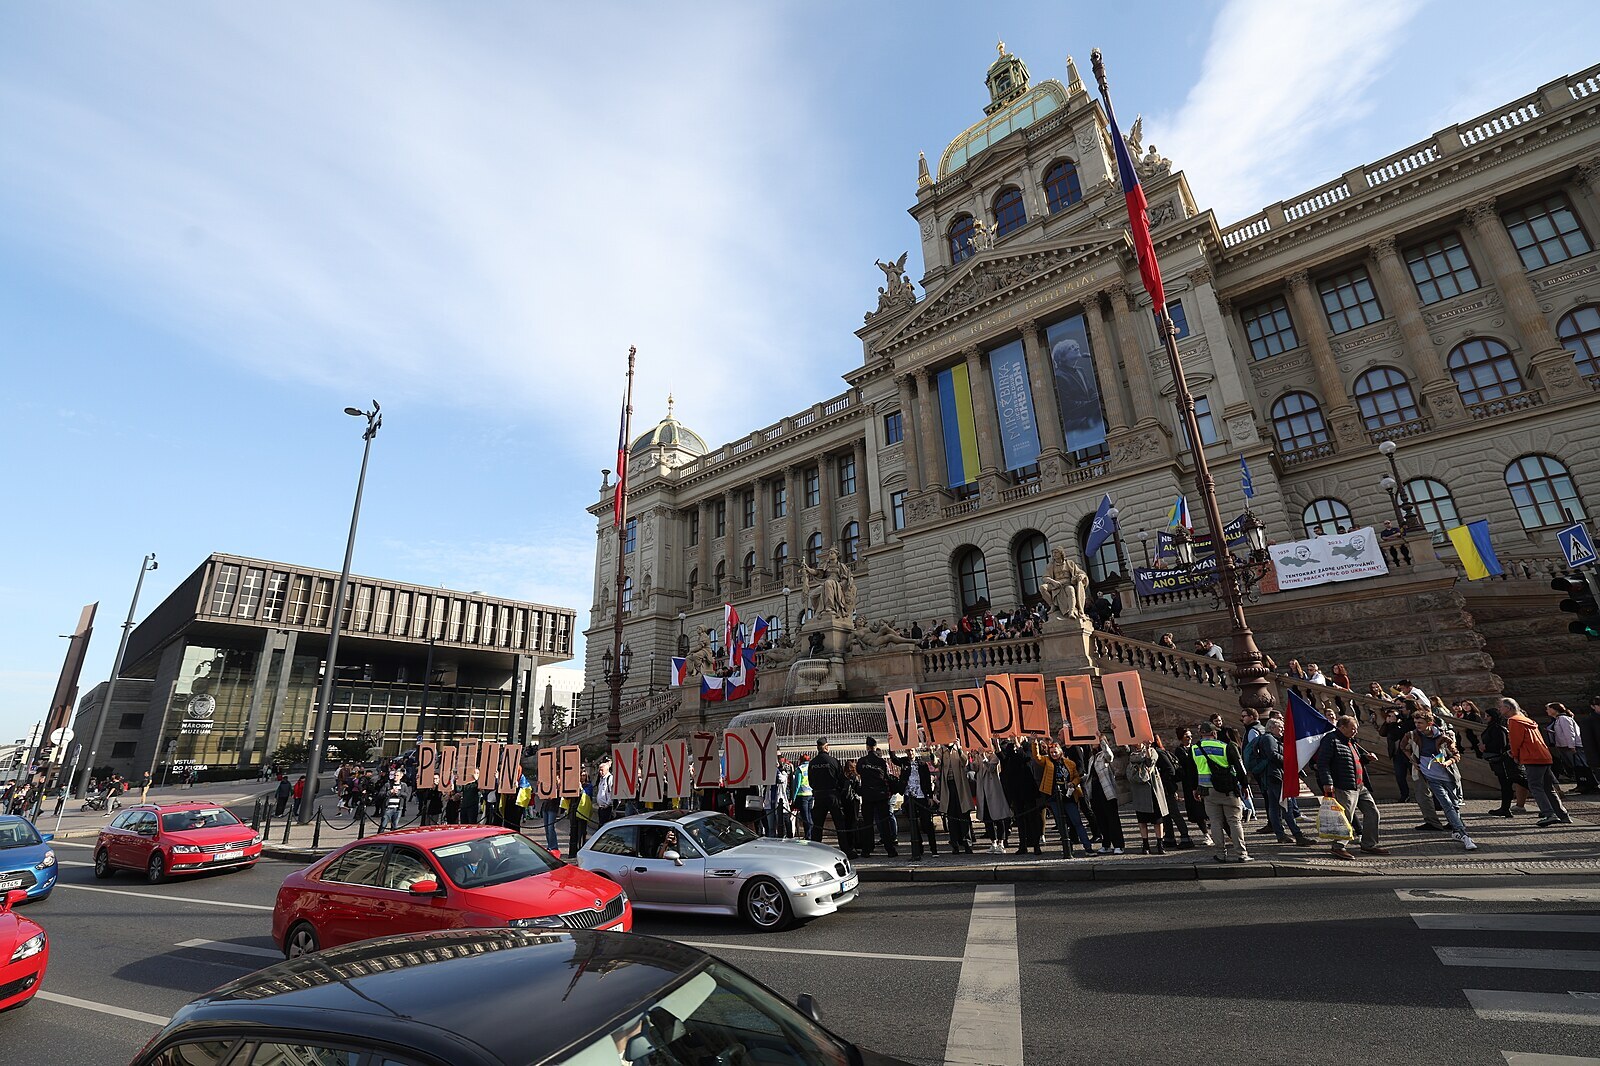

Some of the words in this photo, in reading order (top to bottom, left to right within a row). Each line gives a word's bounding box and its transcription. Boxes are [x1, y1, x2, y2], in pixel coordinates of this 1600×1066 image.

[998, 361, 1012, 408] ŽBIRKA
[1003, 407, 1020, 440] MIRO
[1140, 571, 1153, 580] NE
[1153, 578, 1176, 589] ANO
[419, 742, 519, 789] PUTIN
[540, 749, 578, 795] JE
[614, 726, 774, 799] NAVŽDY
